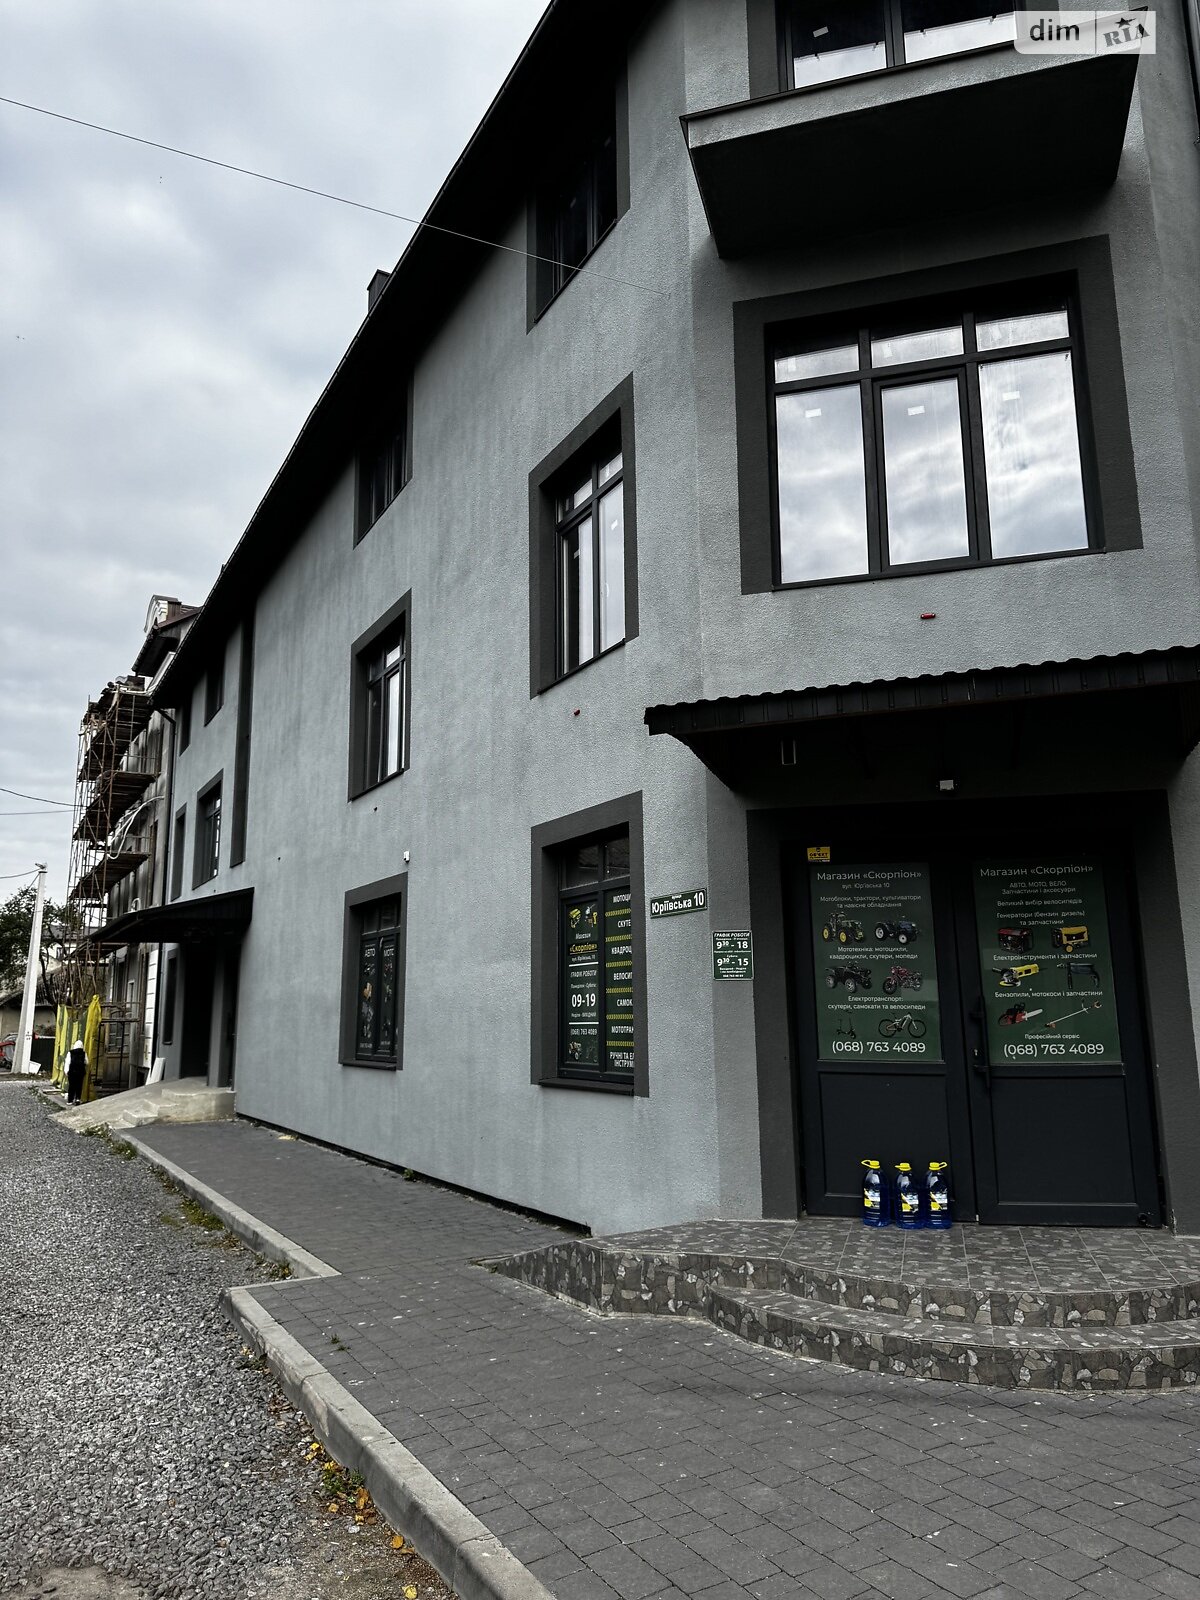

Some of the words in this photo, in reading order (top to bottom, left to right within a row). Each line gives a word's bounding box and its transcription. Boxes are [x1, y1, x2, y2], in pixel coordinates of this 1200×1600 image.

[817, 872, 860, 881] Магазин
[863, 869, 922, 880] «Скорпіон»
[980, 867, 1028, 877] Магазин
[1031, 865, 1094, 876] «Скорпіон»
[651, 898, 692, 915] Юріївська
[693, 891, 705, 907] 10
[737, 940, 749, 949] 18
[737, 957, 749, 966] 15
[993, 953, 1057, 961] Електроінструменти
[571, 993, 596, 1008] 09-19
[832, 1041, 864, 1054] (068)
[866, 1041, 890, 1052] 763
[892, 1041, 926, 1053] 4089
[1003, 1044, 1038, 1058] (068)
[1041, 1044, 1066, 1055] 763
[1069, 1043, 1105, 1055] 4089
